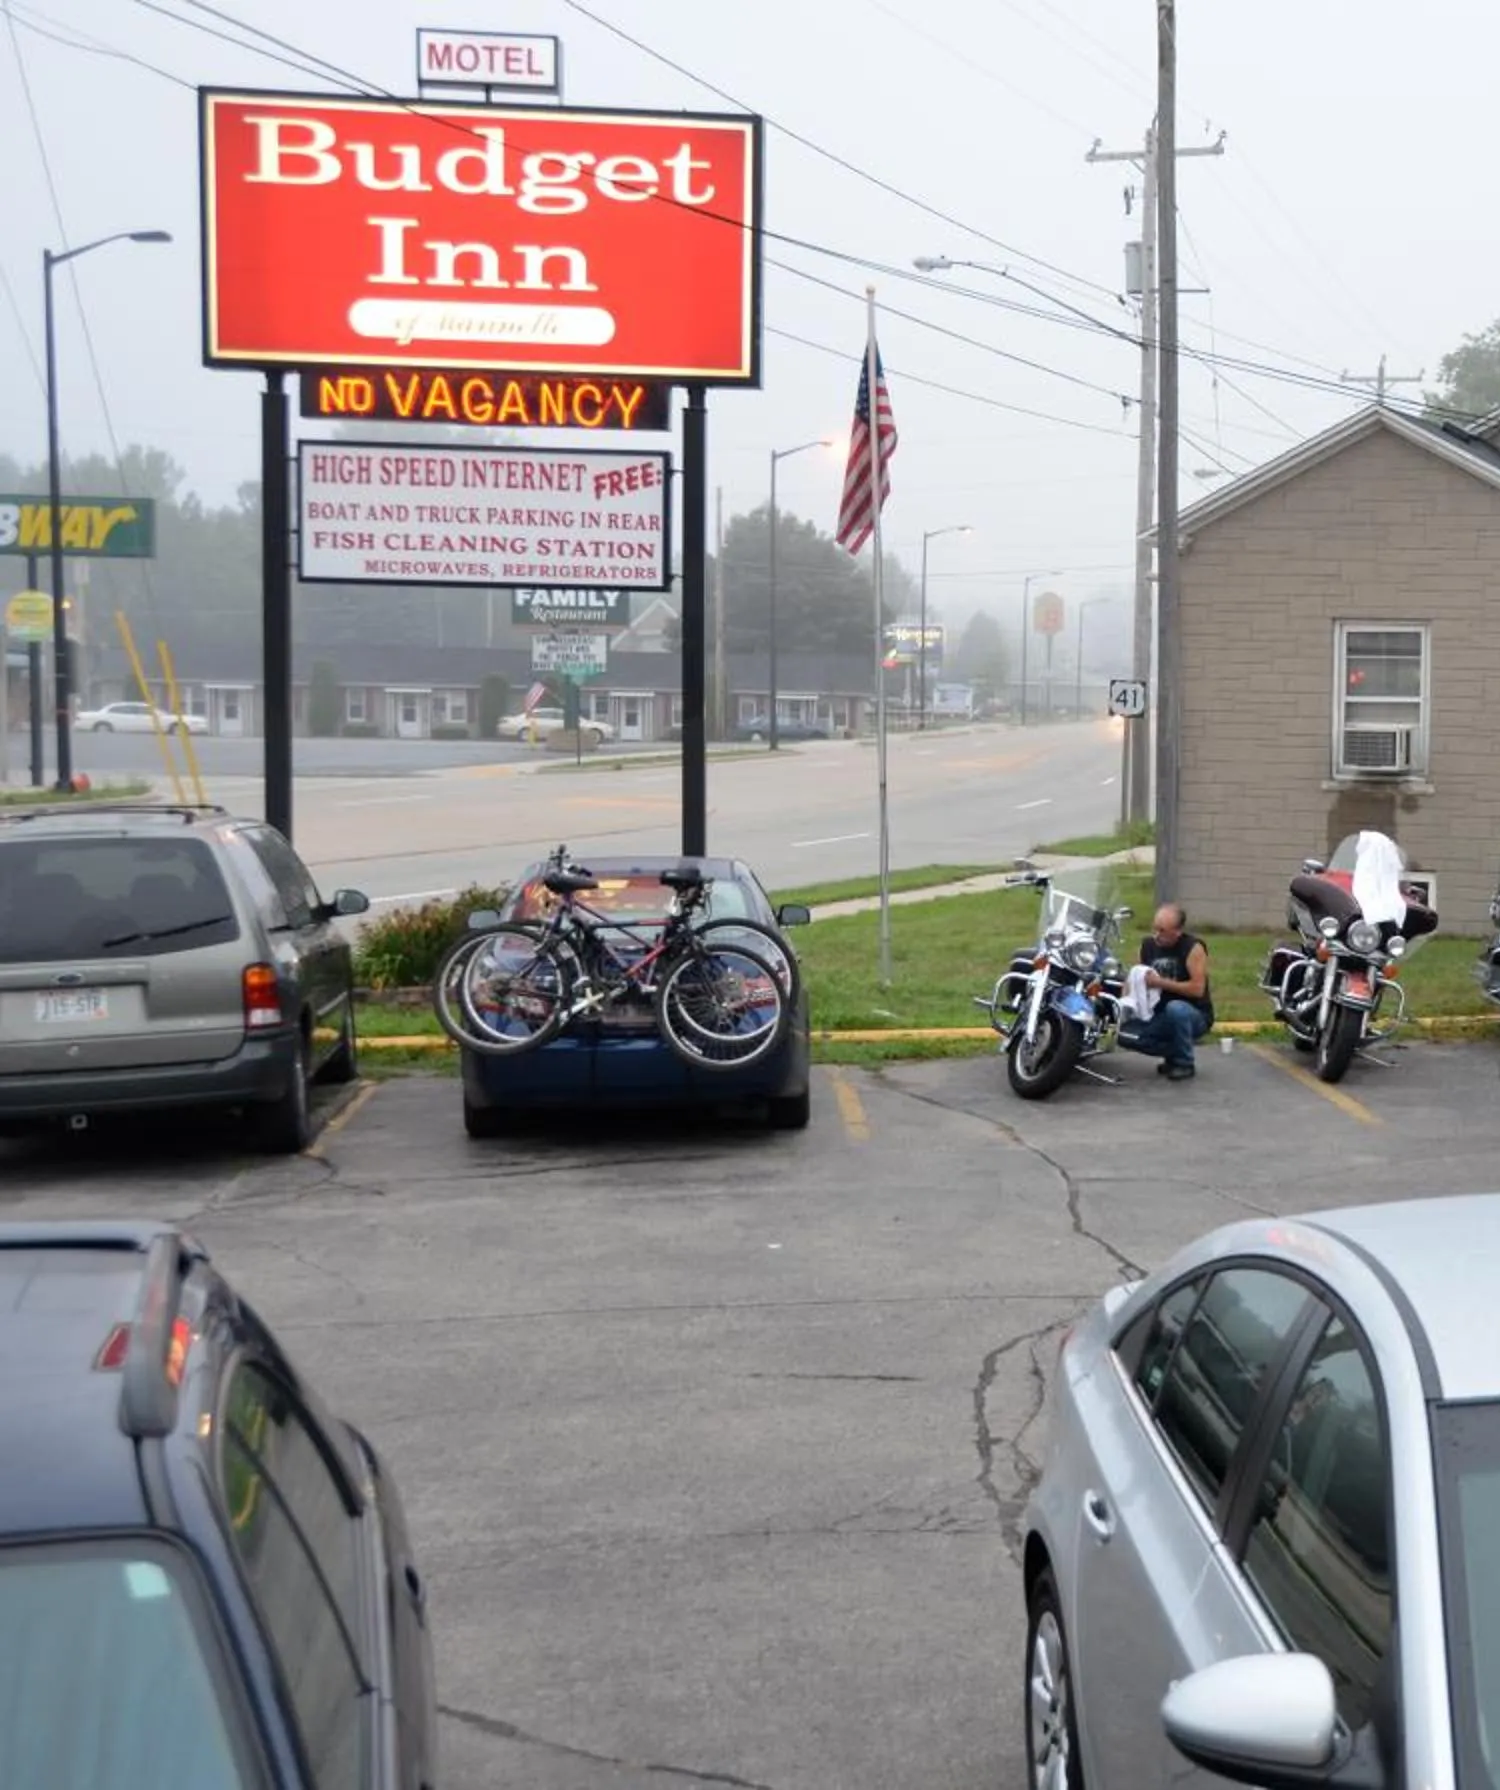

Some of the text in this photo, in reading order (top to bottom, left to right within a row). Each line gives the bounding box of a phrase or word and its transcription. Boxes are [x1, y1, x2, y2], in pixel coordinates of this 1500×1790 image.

[427, 43, 544, 76] MOTEL
[243, 115, 715, 214] Budget
[366, 217, 598, 292] Inn
[312, 454, 372, 485] HIGH
[379, 456, 456, 487] SPEED
[462, 459, 588, 492] INTERNET
[308, 502, 661, 532] BOAT AND TRUCK PARKING IN REAR
[313, 531, 655, 559] FISH CLEANING STATION
[503, 563, 658, 580] REFRIGERATORS
[514, 588, 620, 607] FAMILY
[1115, 688, 1138, 709] 41
